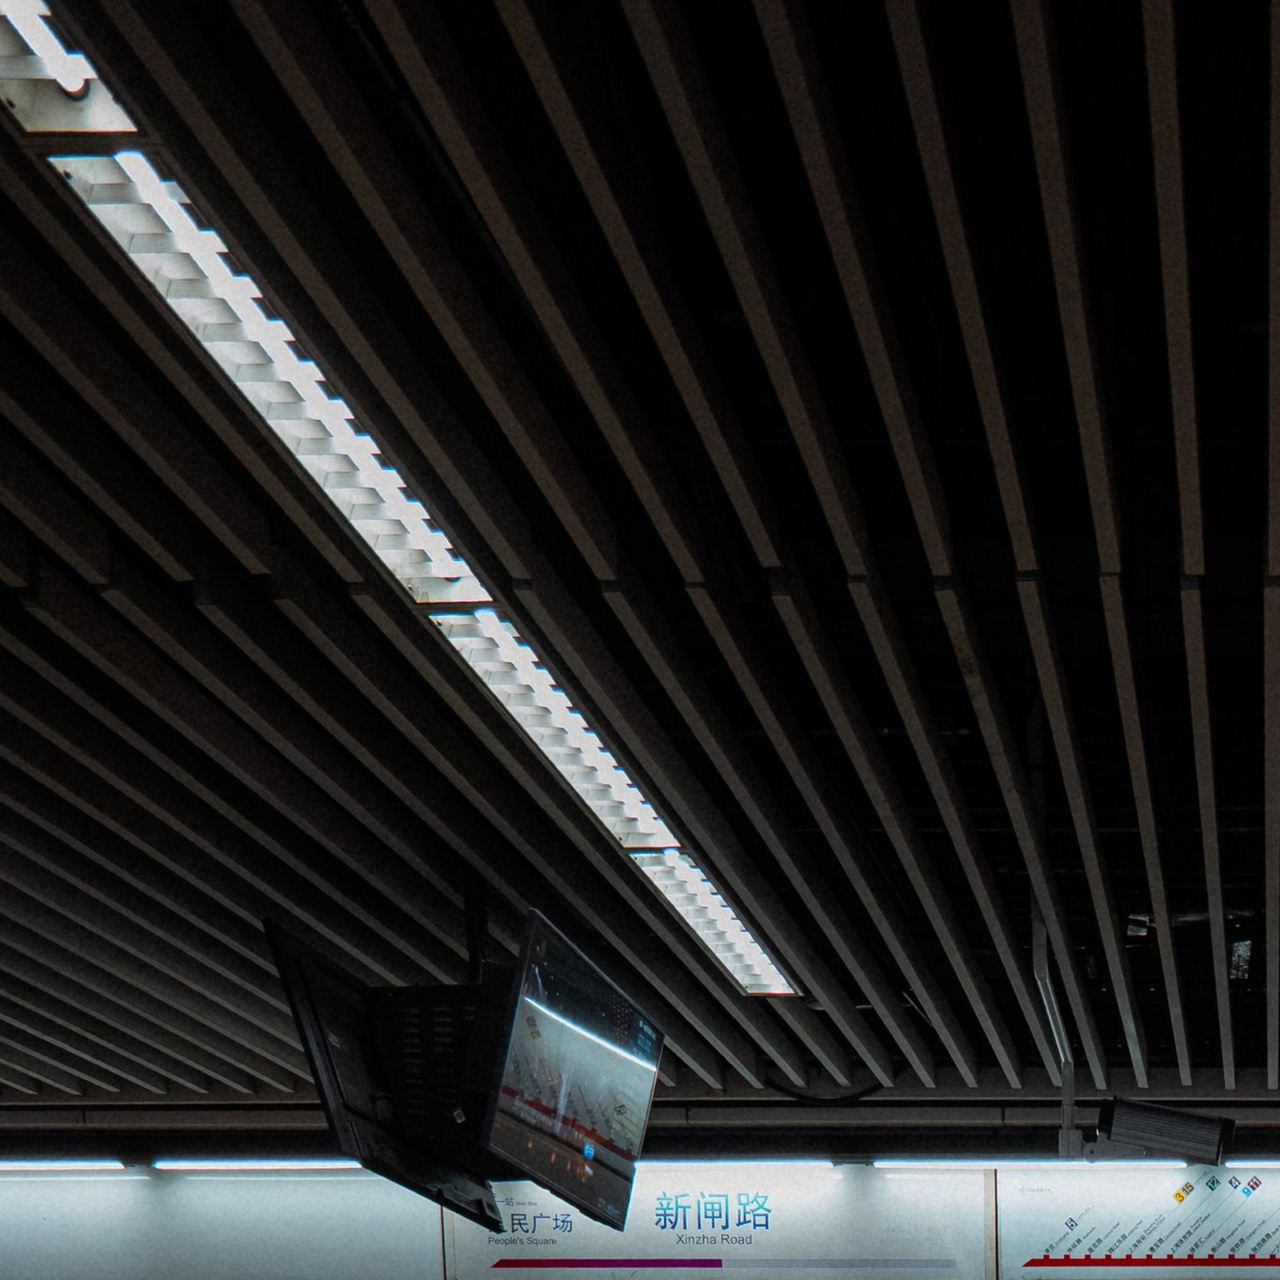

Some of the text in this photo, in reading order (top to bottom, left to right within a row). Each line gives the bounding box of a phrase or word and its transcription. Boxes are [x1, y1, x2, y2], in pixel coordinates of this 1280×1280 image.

[1208, 1178, 1219, 1189] 12
[1230, 1178, 1239, 1187] 4
[1243, 1178, 1260, 1196] 9 11
[1174, 1183, 1193, 1202] 3 15
[494, 1197, 514, 1207] 一站
[655, 1191, 772, 1230] 新闸路
[490, 1213, 573, 1234] 民广场
[1067, 1219, 1076, 1229] 5
[488, 1237, 557, 1247] People's Square
[676, 1234, 752, 1245] Xinzha Road
